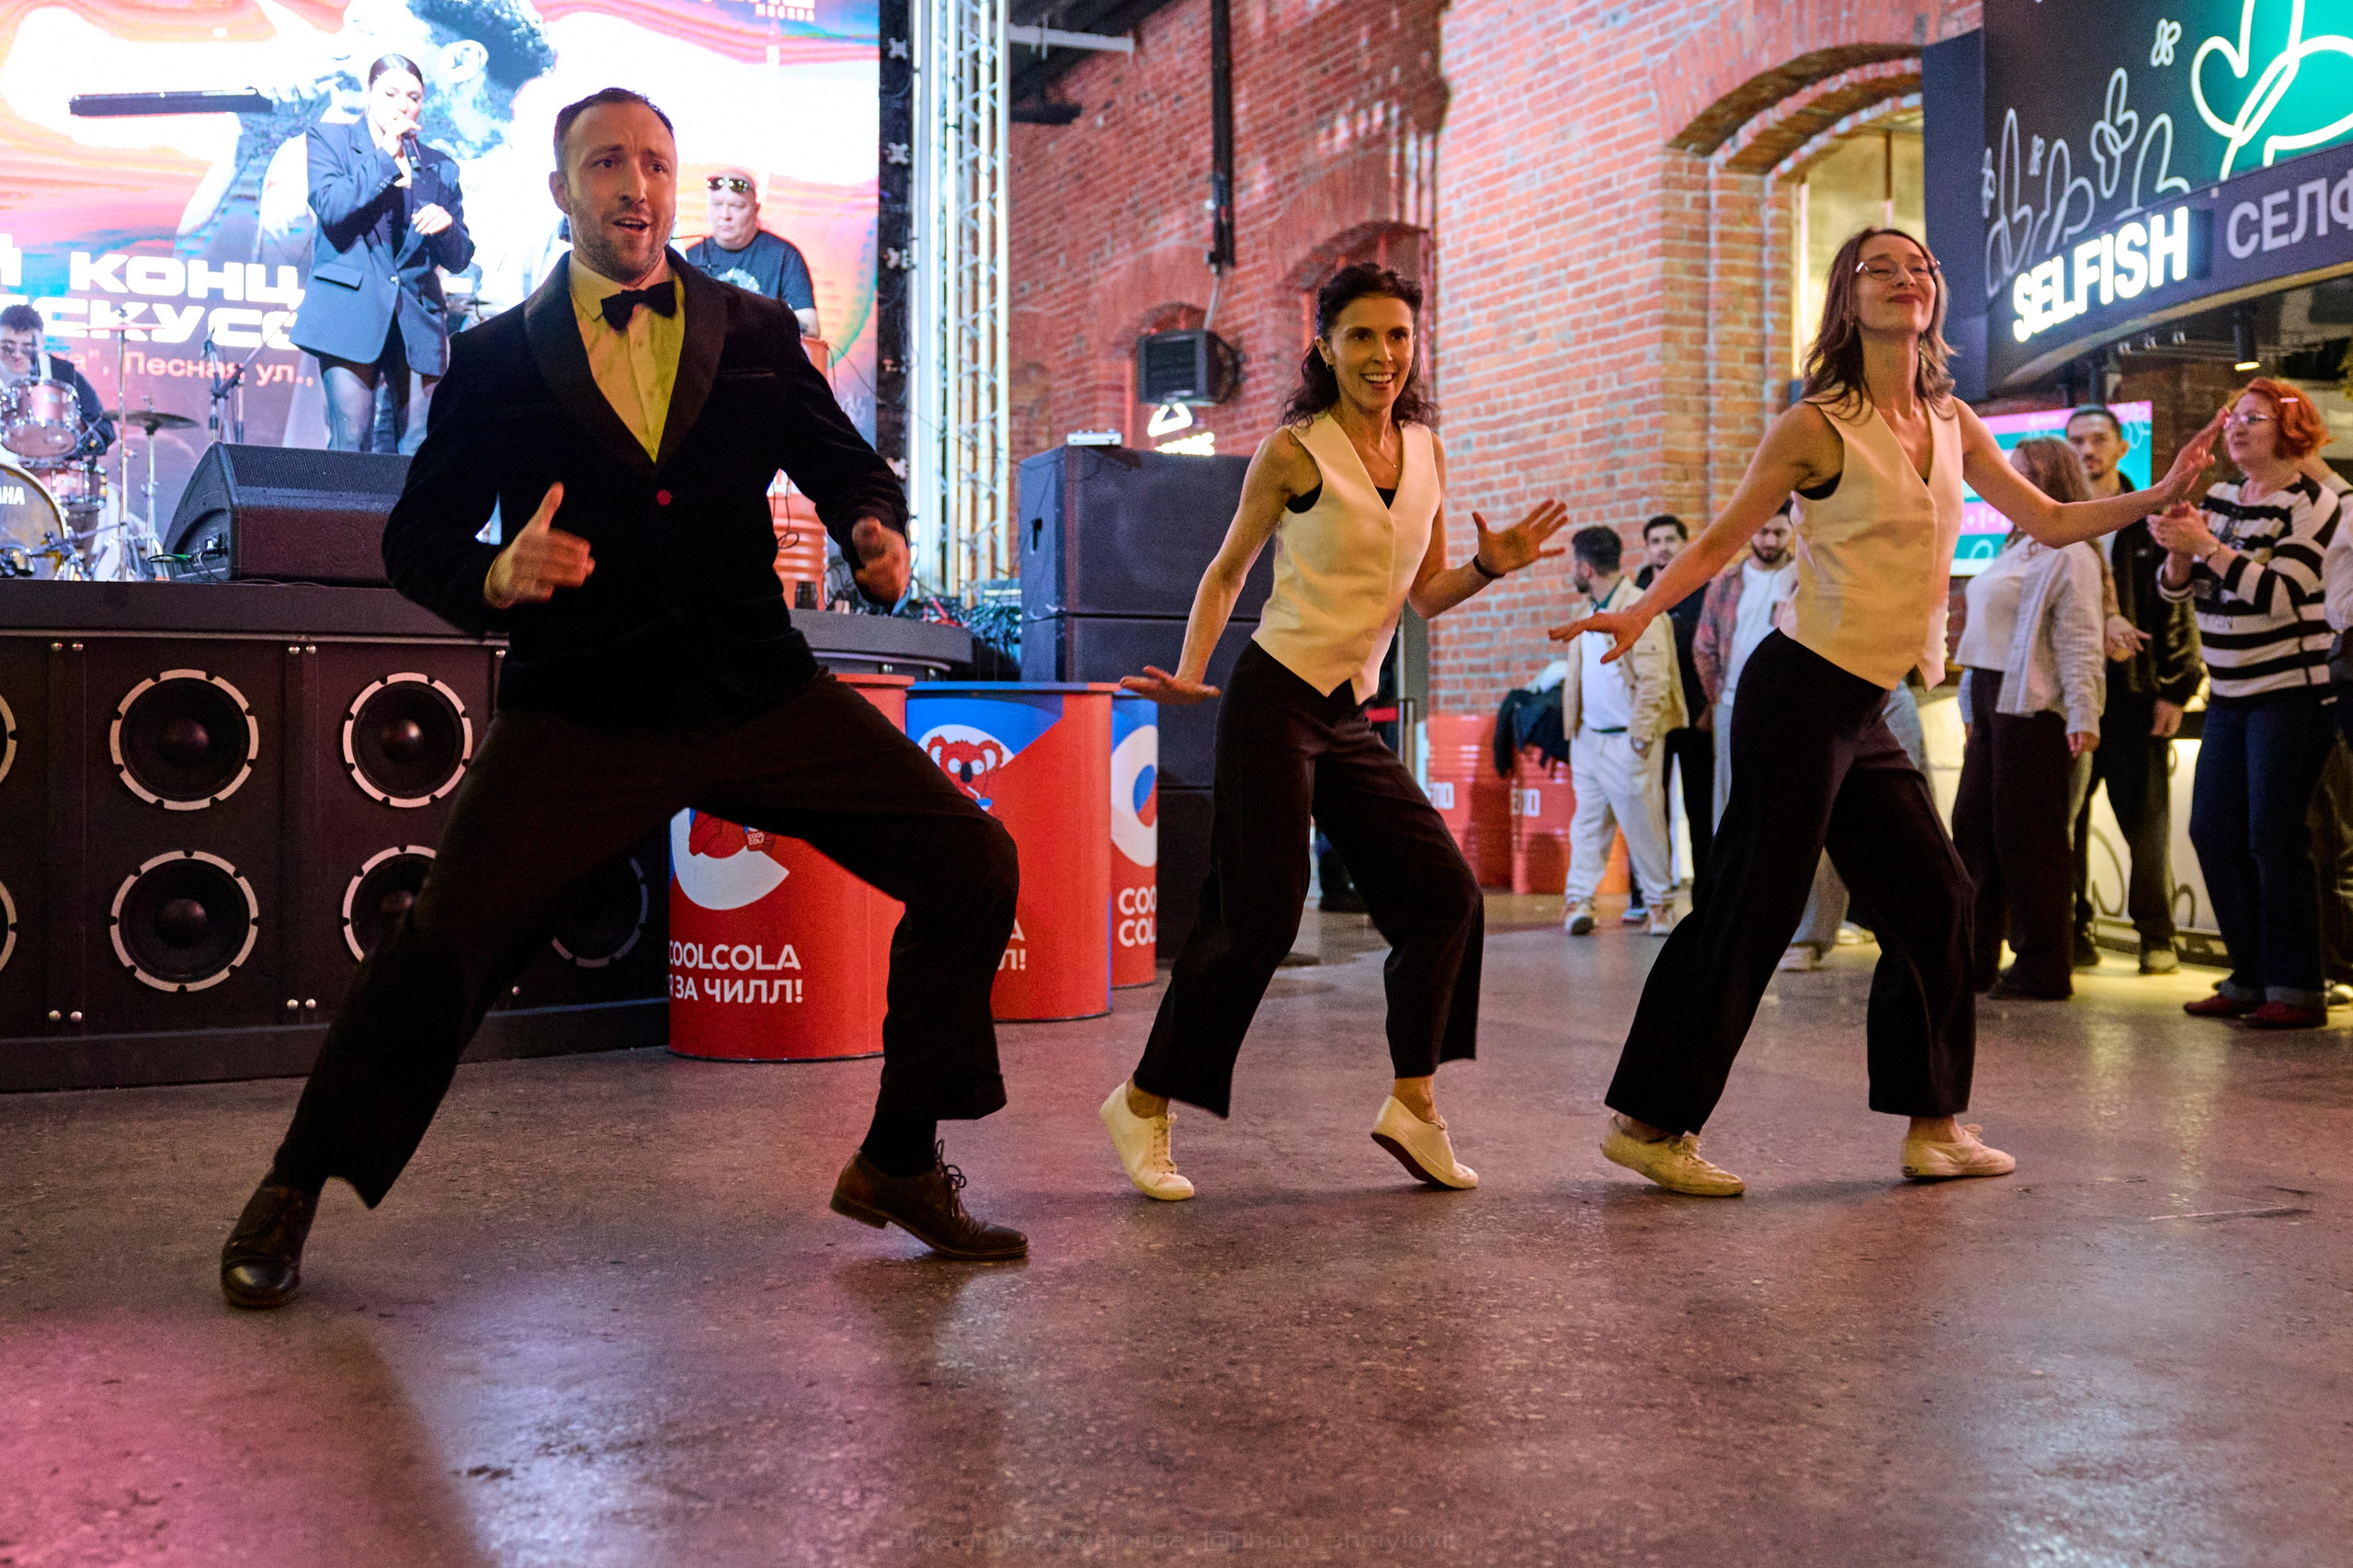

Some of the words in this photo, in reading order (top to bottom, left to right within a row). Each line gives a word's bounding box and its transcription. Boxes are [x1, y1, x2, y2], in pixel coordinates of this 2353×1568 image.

[70, 251, 306, 311] КОНЦ
[2013, 206, 2189, 343] SELFISH
[0, 293, 299, 350] СКУСС
[675, 975, 699, 1001] ЗА
[704, 977, 803, 1004] ЧИЛЛ!
